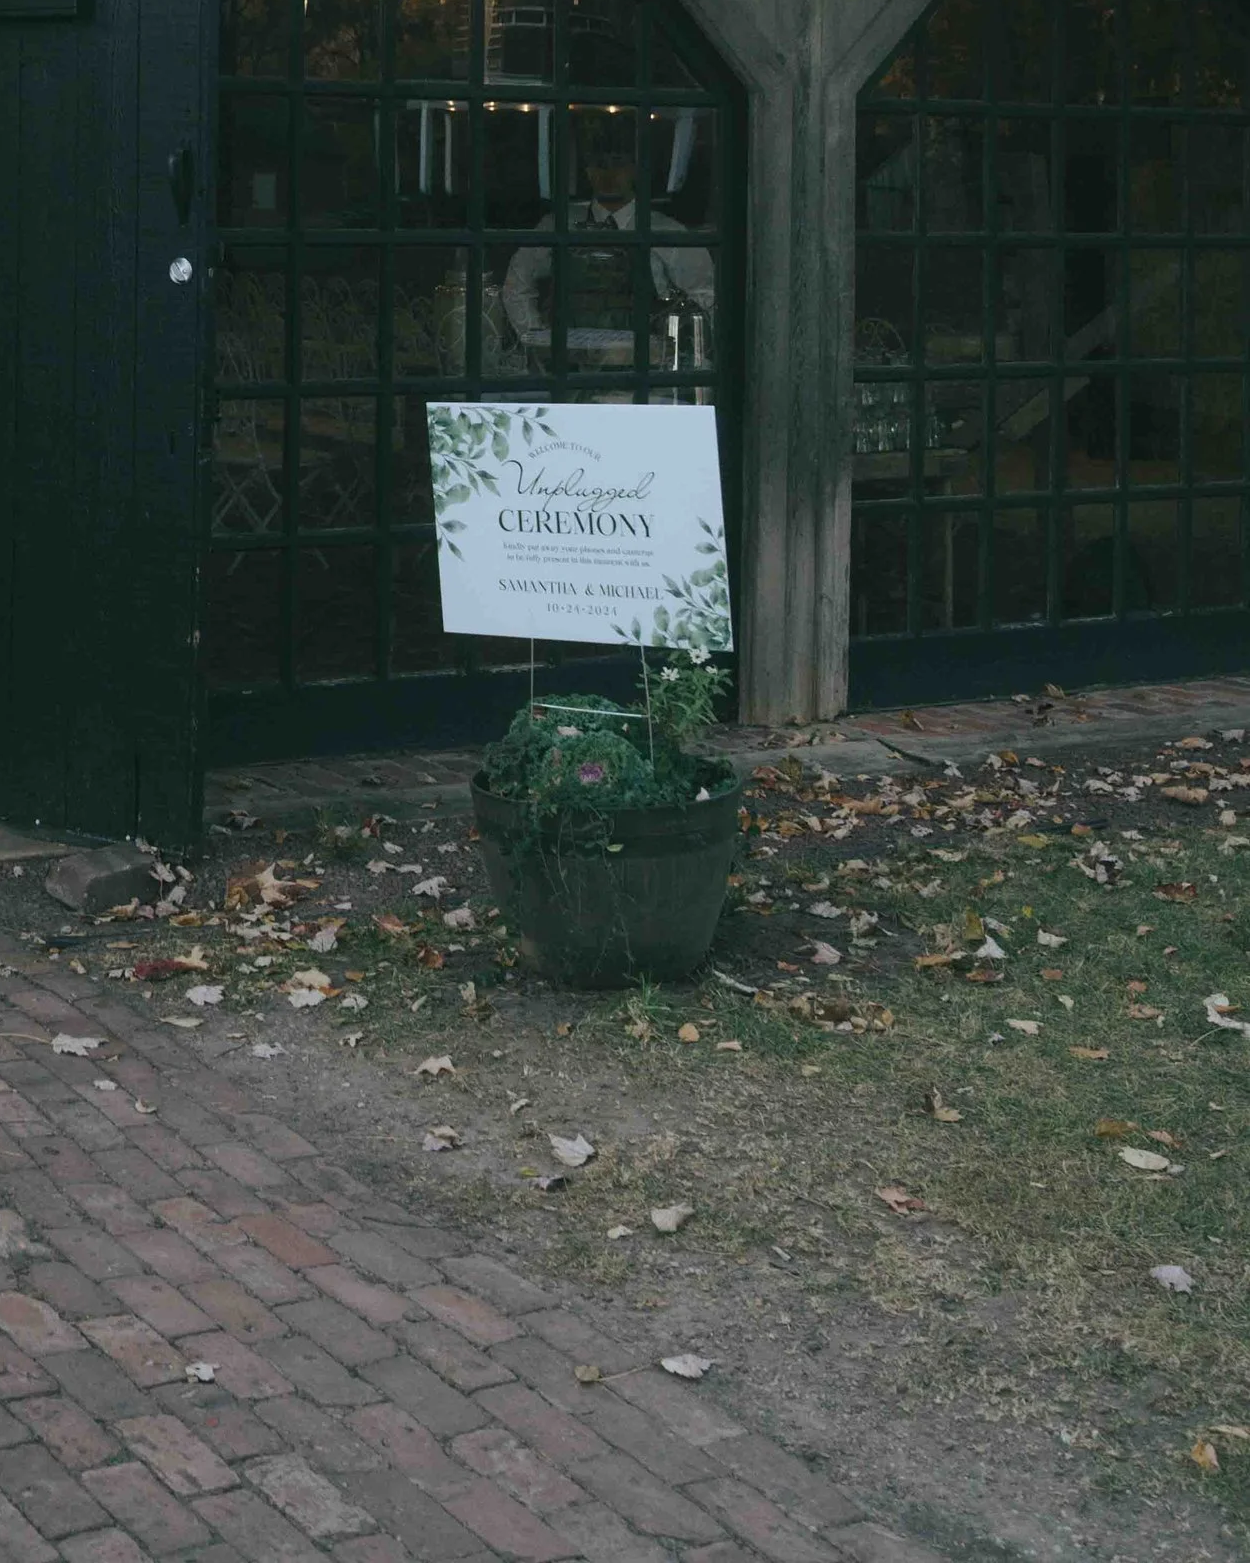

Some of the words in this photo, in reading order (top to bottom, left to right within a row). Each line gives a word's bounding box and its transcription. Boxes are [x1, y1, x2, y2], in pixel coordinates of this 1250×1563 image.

[527, 441, 568, 460] WELCOME
[570, 442, 582, 451] TO
[583, 446, 602, 462] OUR
[501, 459, 655, 513] Unplugged
[498, 509, 655, 538] CEREMONY
[526, 554, 541, 564] fully
[543, 556, 570, 564] present
[579, 555, 592, 564] this
[541, 545, 559, 554] away
[579, 544, 606, 555] phones
[606, 546, 621, 555] and
[498, 578, 577, 596] SAMANTHA
[584, 582, 595, 596] &
[599, 583, 664, 601] MICHAEL
